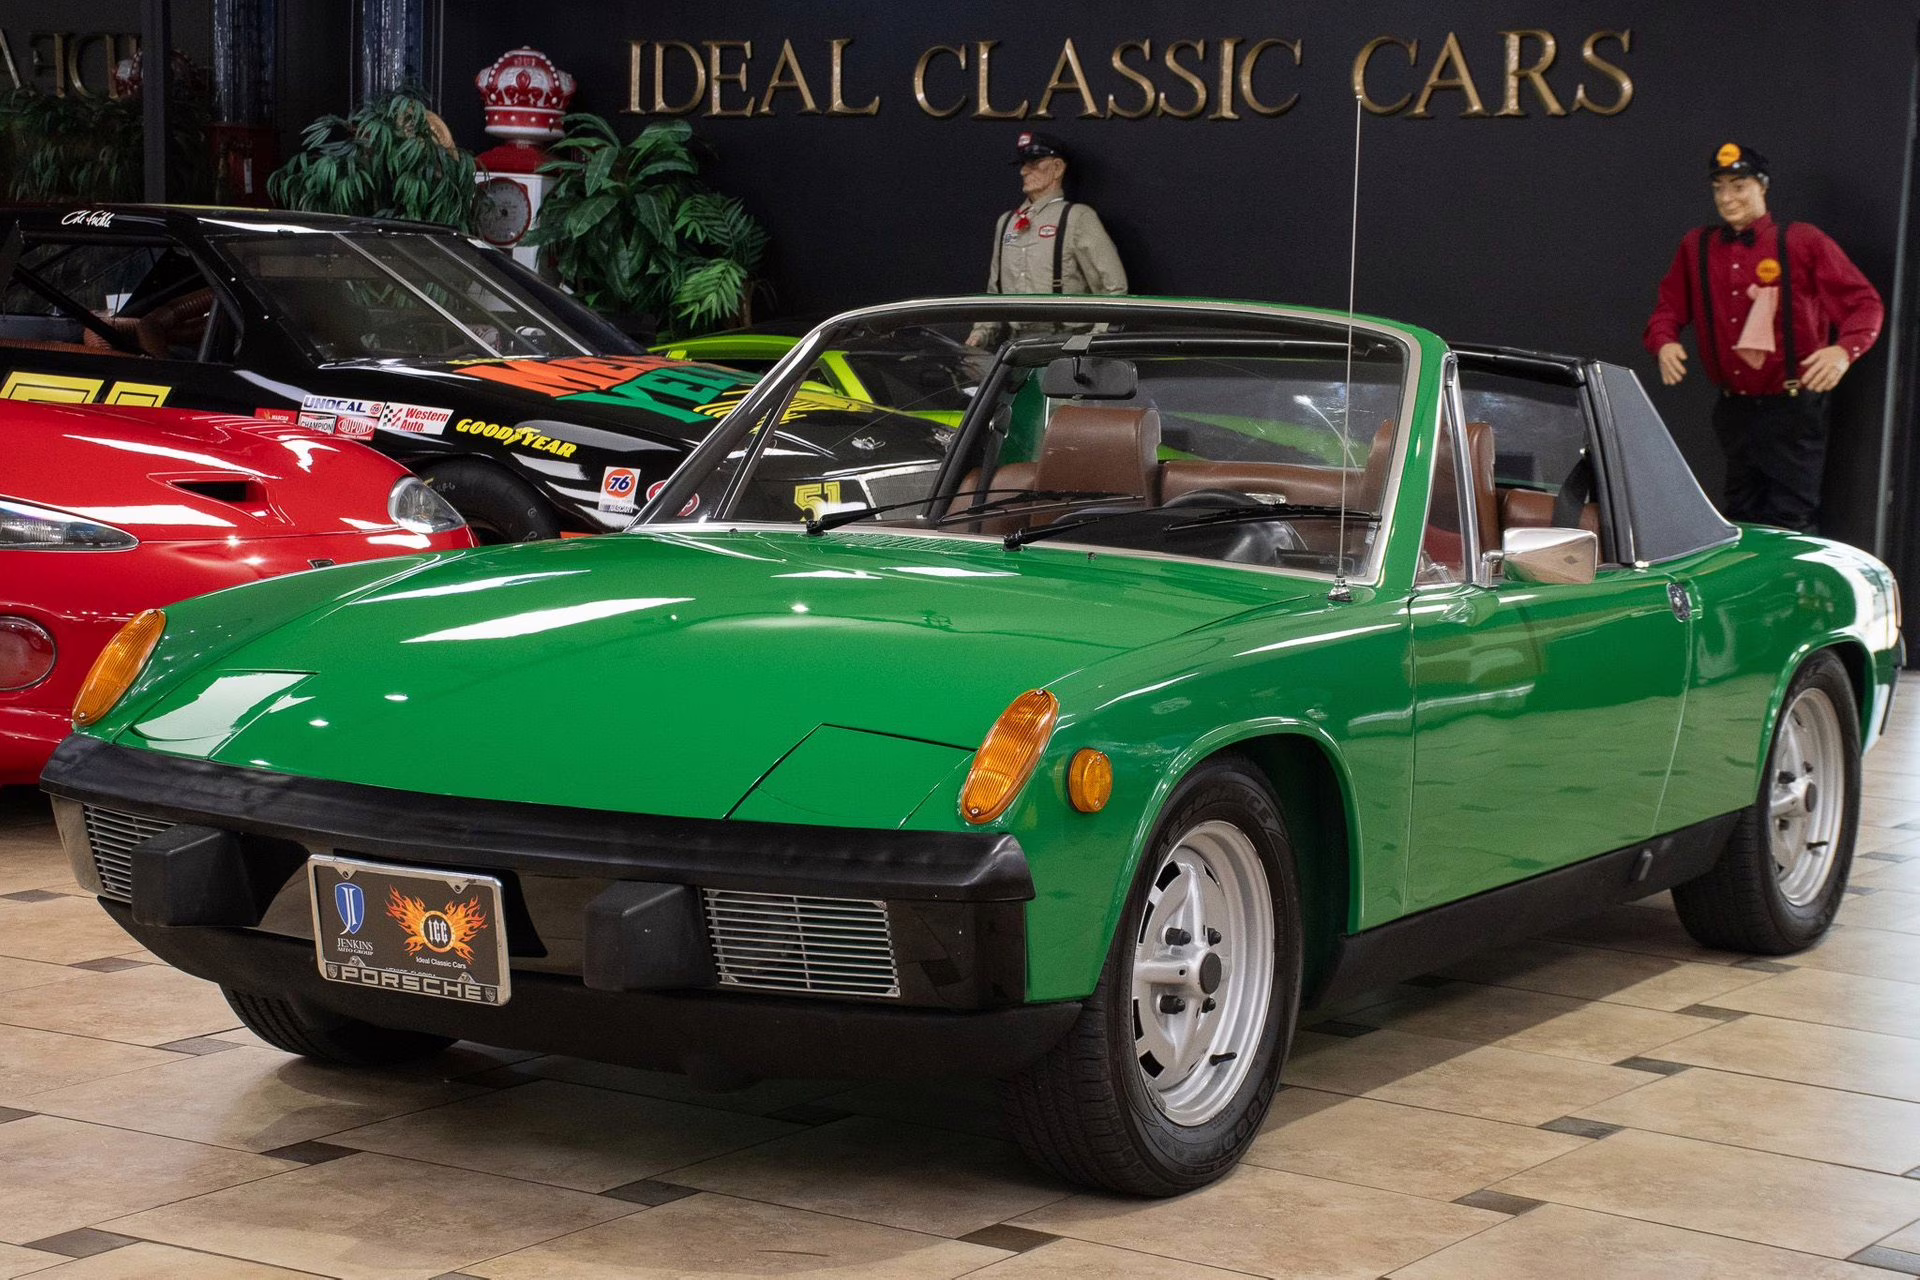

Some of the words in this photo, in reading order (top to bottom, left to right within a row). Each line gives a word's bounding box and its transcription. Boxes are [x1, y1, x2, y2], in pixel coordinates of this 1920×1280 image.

[619, 39, 880, 117] IDEAL
[913, 38, 1302, 120] CLASSIC
[1353, 28, 1634, 119] CARS
[303, 396, 366, 413] UNOCAL
[405, 407, 449, 423] Western
[300, 420, 334, 432] CHAMPION
[456, 418, 578, 458] GOODYEAR
[607, 474, 633, 492] 76
[793, 481, 842, 522] 51
[336, 937, 374, 951] JENKINS
[336, 947, 355, 955] AUTO
[415, 956, 431, 966] Ideal
[430, 957, 452, 968] Classic
[452, 961, 467, 970] Cars
[341, 966, 481, 1000] PORSCHE
